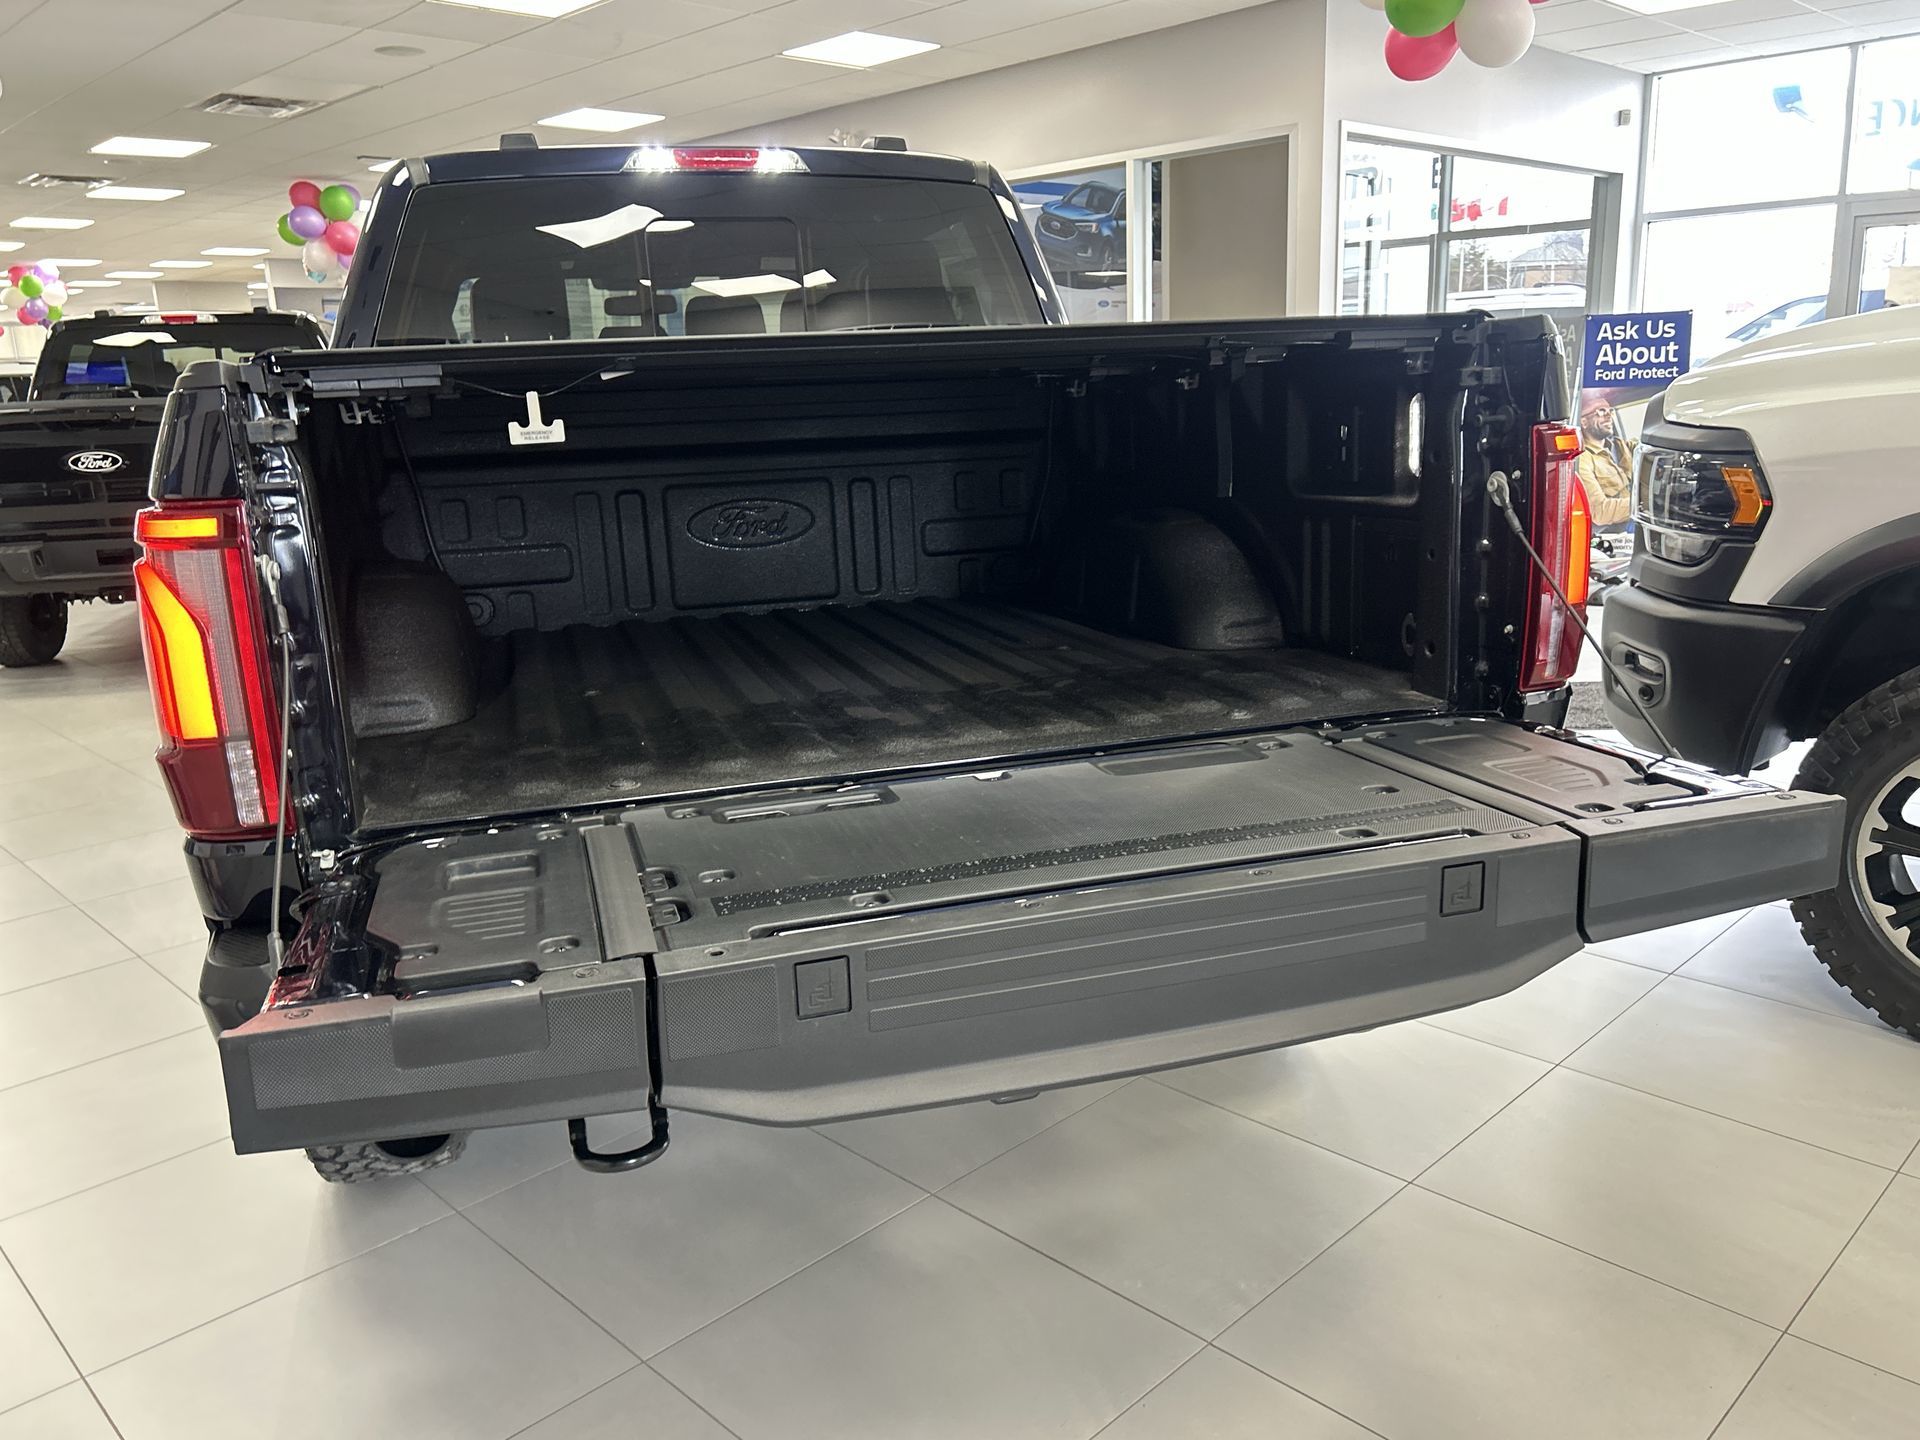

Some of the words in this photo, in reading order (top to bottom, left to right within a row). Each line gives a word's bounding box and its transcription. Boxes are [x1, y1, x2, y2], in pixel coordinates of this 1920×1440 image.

[1596, 320, 1640, 341] Ask
[1646, 319, 1676, 338] Us
[1595, 341, 1680, 366] About
[1595, 368, 1625, 381] Ford
[1629, 366, 1679, 379] Protect
[77, 454, 113, 469] Ford
[711, 505, 789, 538] Ford
